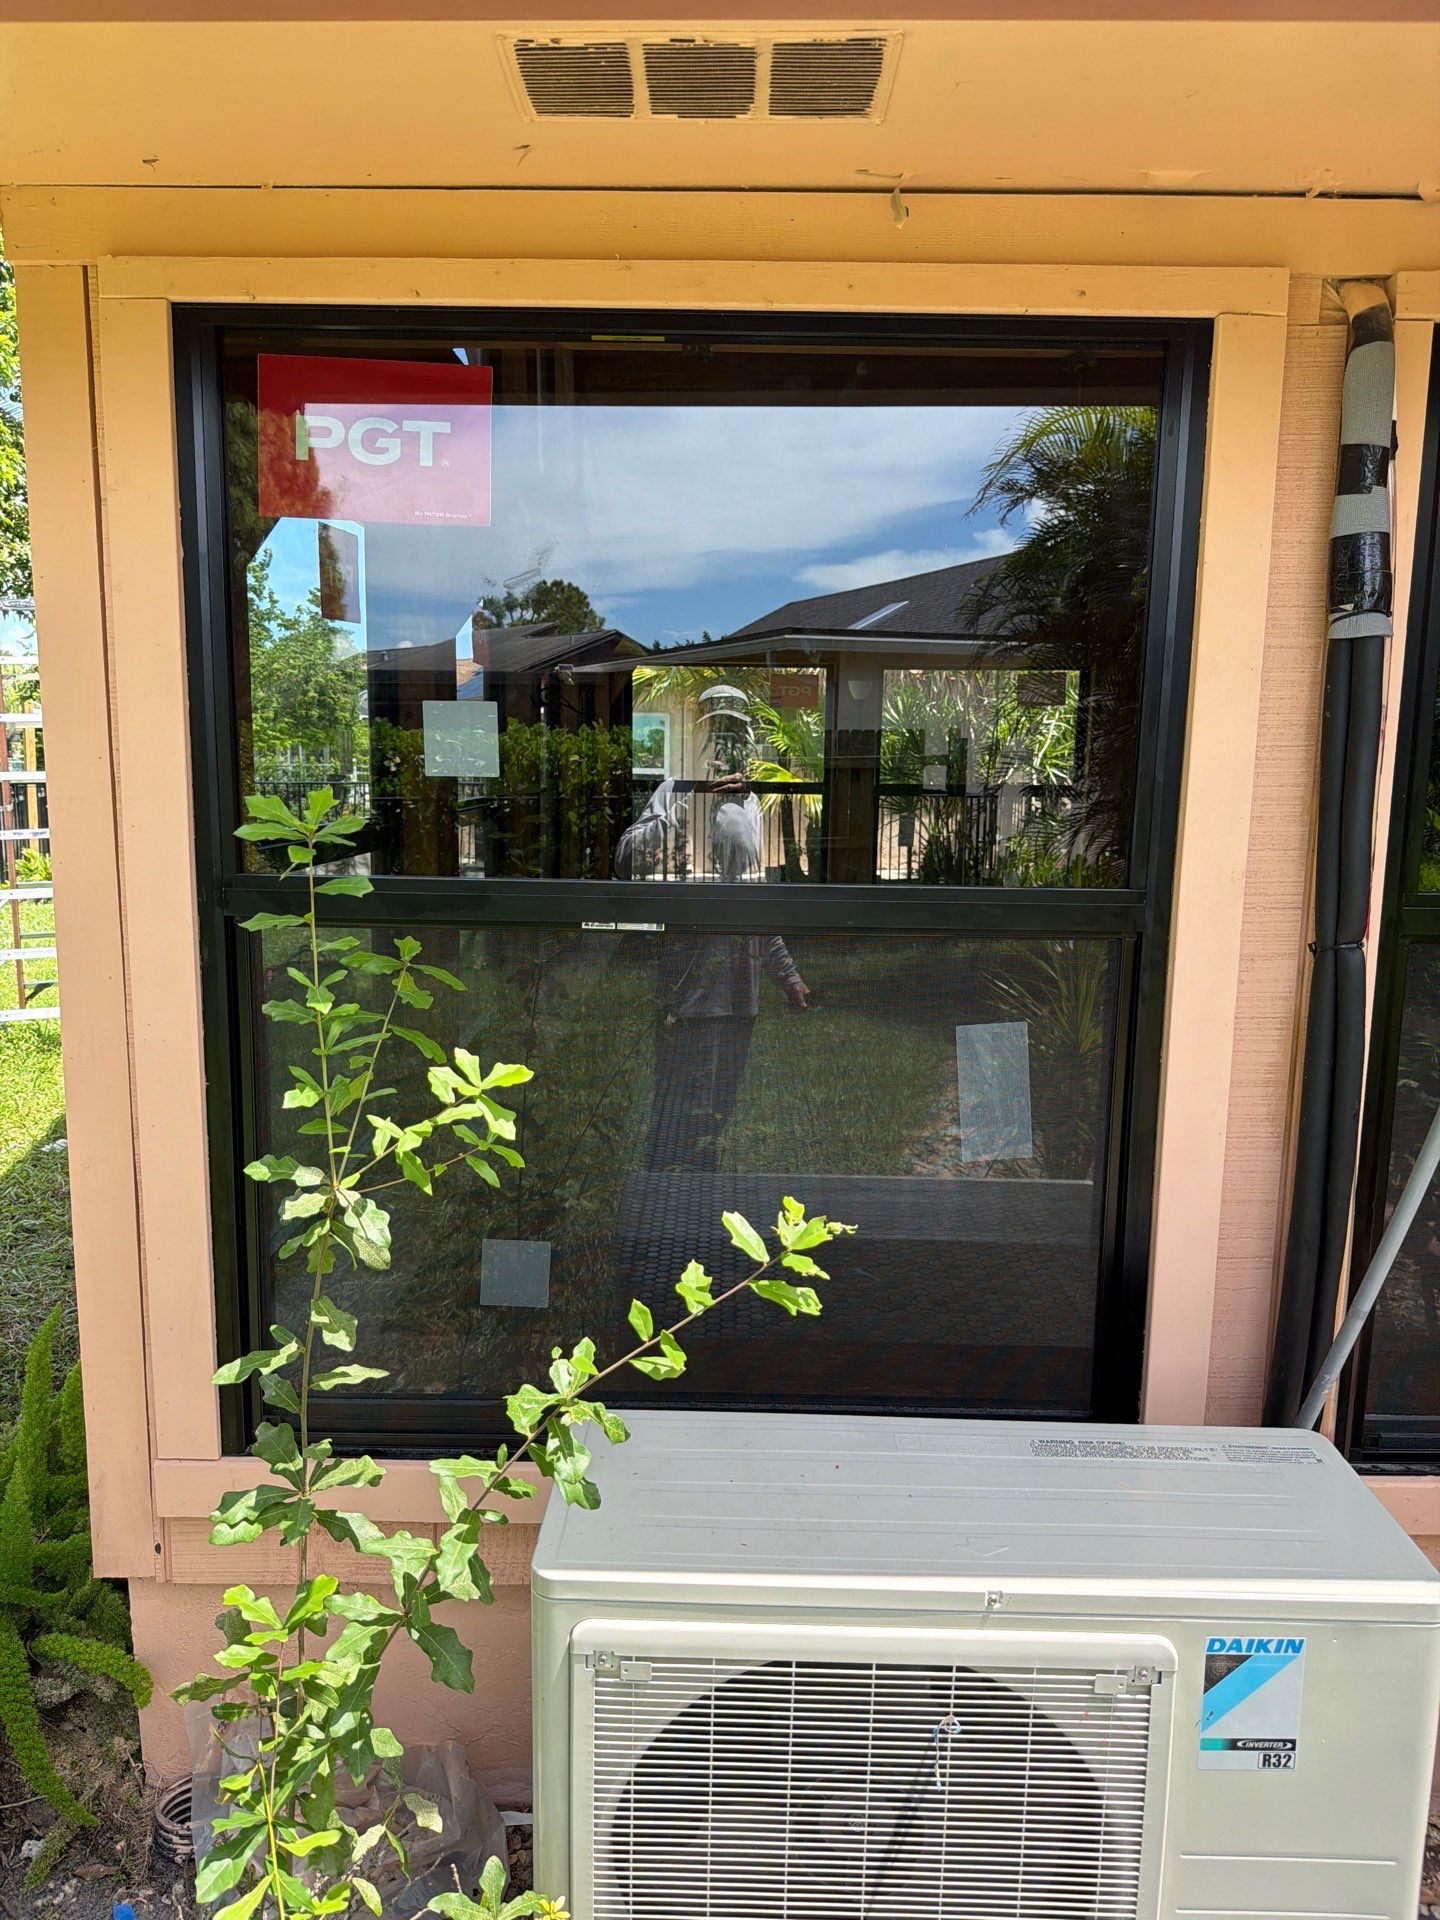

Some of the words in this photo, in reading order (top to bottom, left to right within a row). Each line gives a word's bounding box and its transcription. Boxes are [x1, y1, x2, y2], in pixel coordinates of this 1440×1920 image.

[295, 415, 451, 467] PGT
[1206, 1638, 1304, 1654] DAIKIN
[1245, 1741, 1284, 1749] INVERTER
[1262, 1753, 1292, 1768] R32
